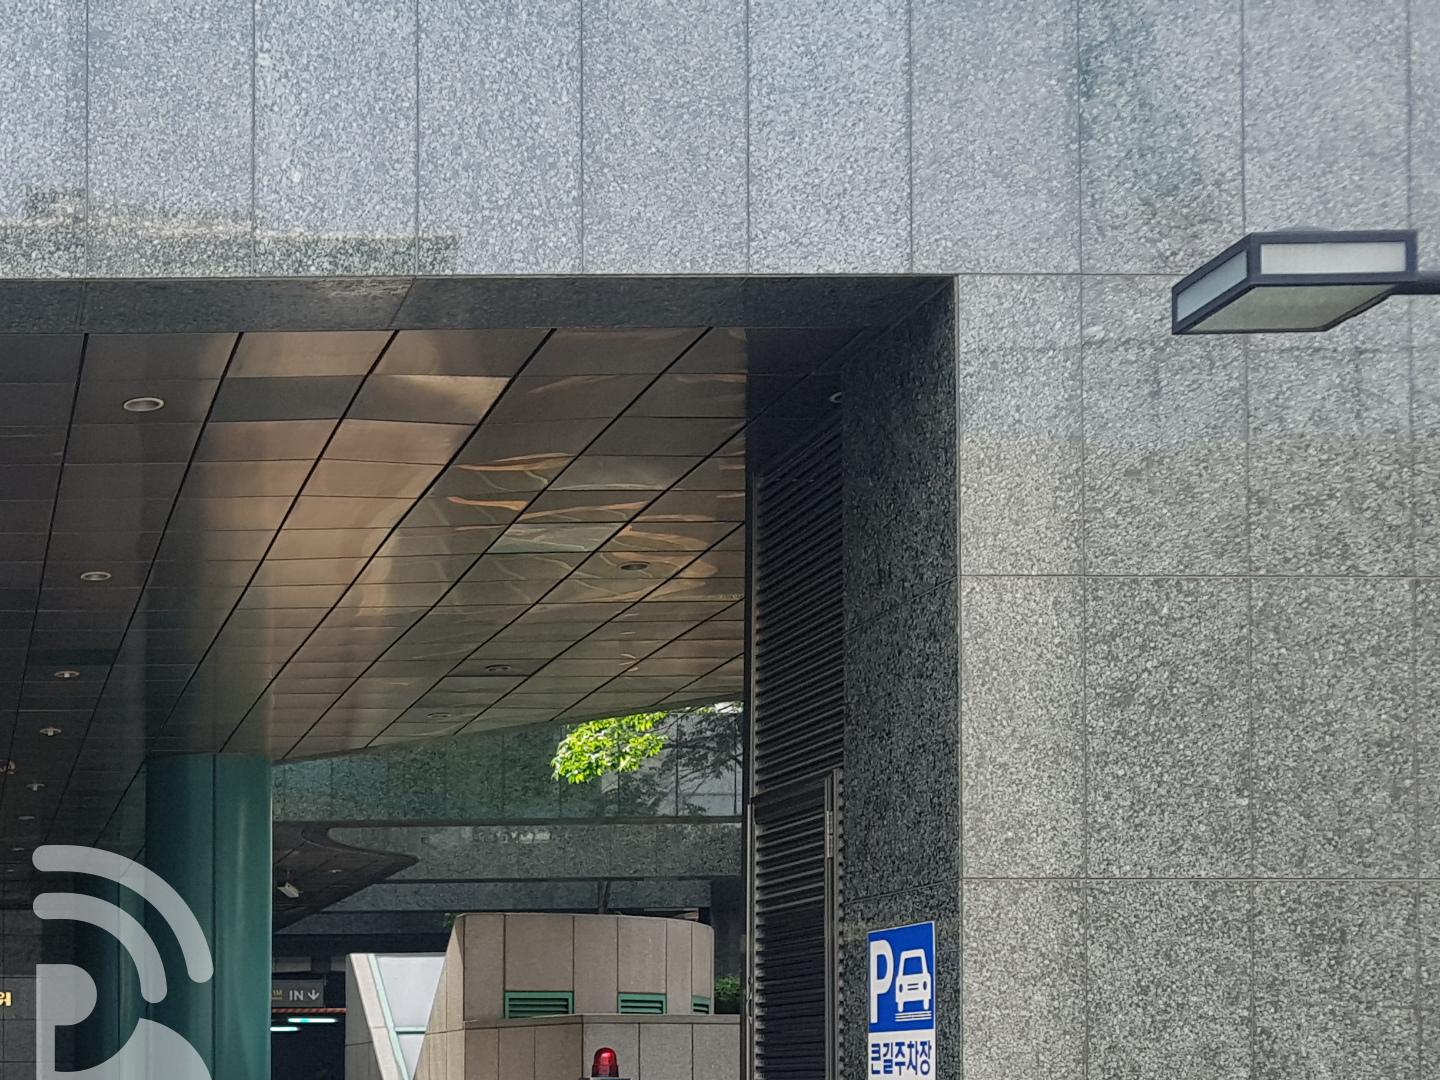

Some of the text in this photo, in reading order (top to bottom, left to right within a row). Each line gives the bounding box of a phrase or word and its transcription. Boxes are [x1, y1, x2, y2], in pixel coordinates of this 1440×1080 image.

[289, 989, 304, 1001] IN
[869, 939, 894, 1024] P
[871, 1039, 932, 1077] 큰길주차장
